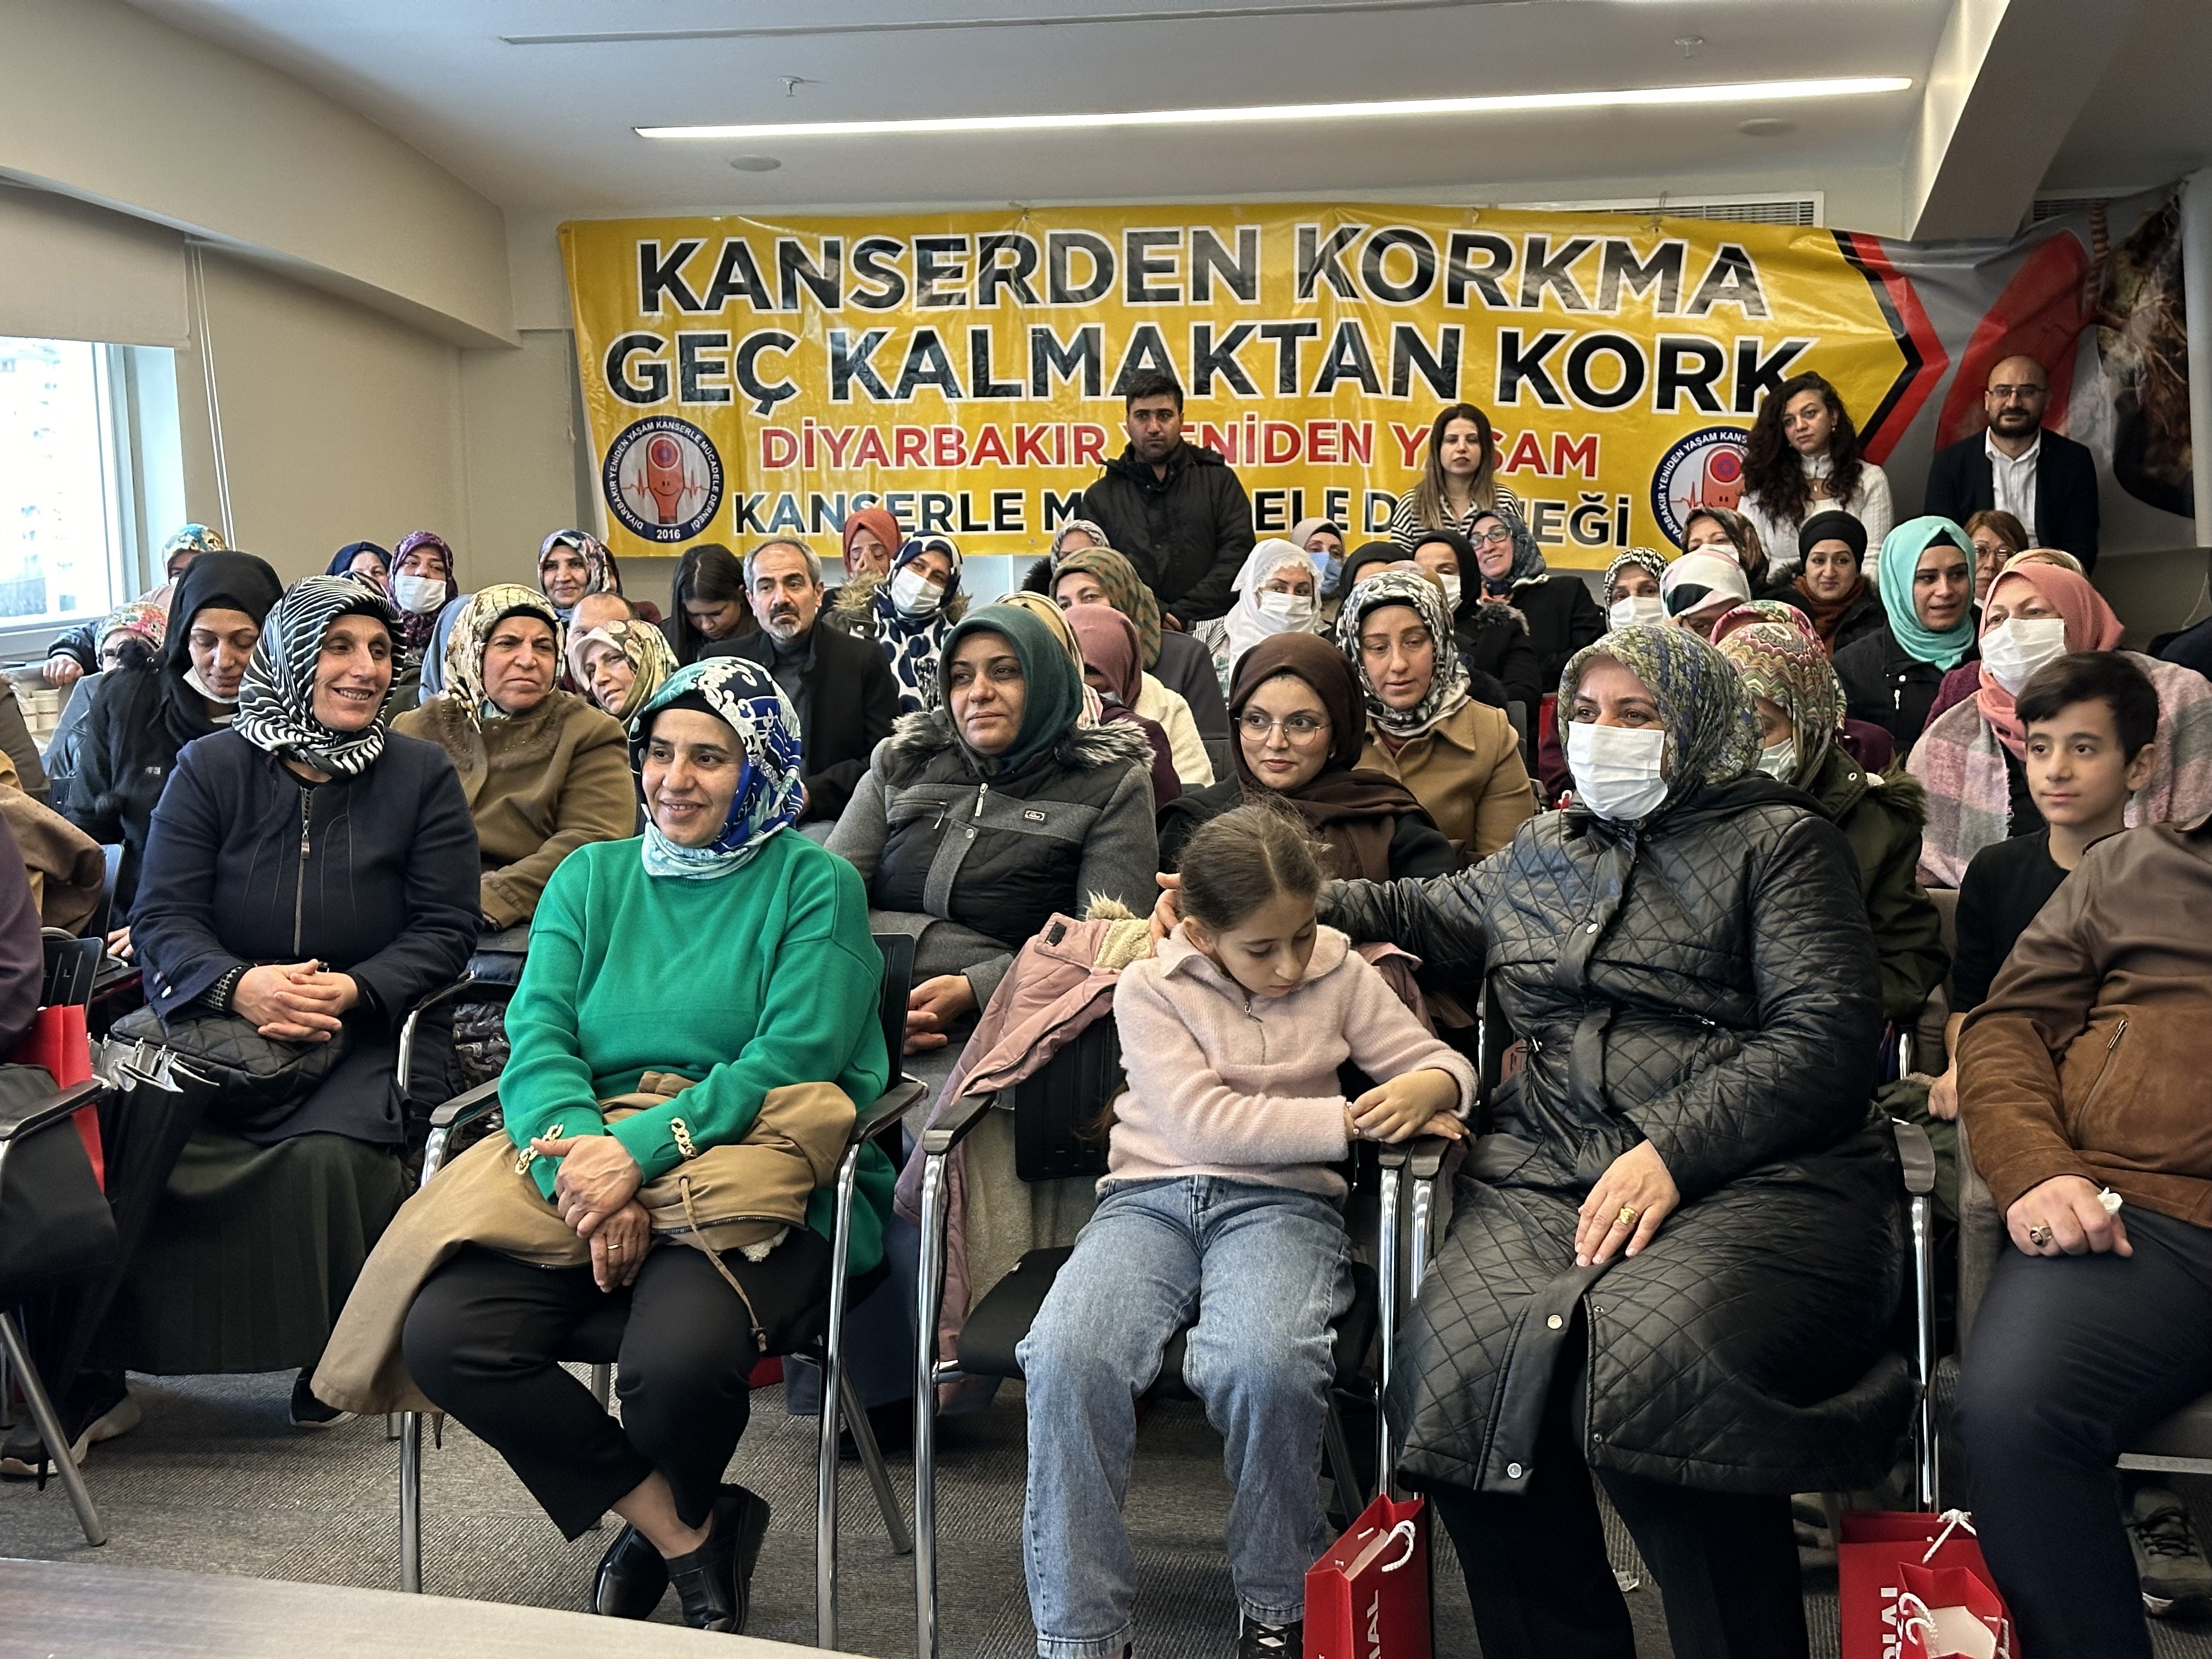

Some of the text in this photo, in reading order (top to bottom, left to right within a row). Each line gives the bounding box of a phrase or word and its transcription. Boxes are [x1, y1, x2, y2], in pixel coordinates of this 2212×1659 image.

[639, 226, 1770, 318] KANSERDEN KORKMA
[605, 323, 1814, 415] GEÇ KALMAKTAN KORK
[609, 421, 720, 531] DİYARBAKIR YENİDEN YAŞAM KANSERLE MÜCADELE DERNEĞİ
[761, 413, 1599, 477] DİYARBAKIR NİDEN YAM
[1658, 449, 1685, 491] YENİDEN
[1683, 432, 1718, 452] YAŞAM
[656, 529, 681, 539] 2016
